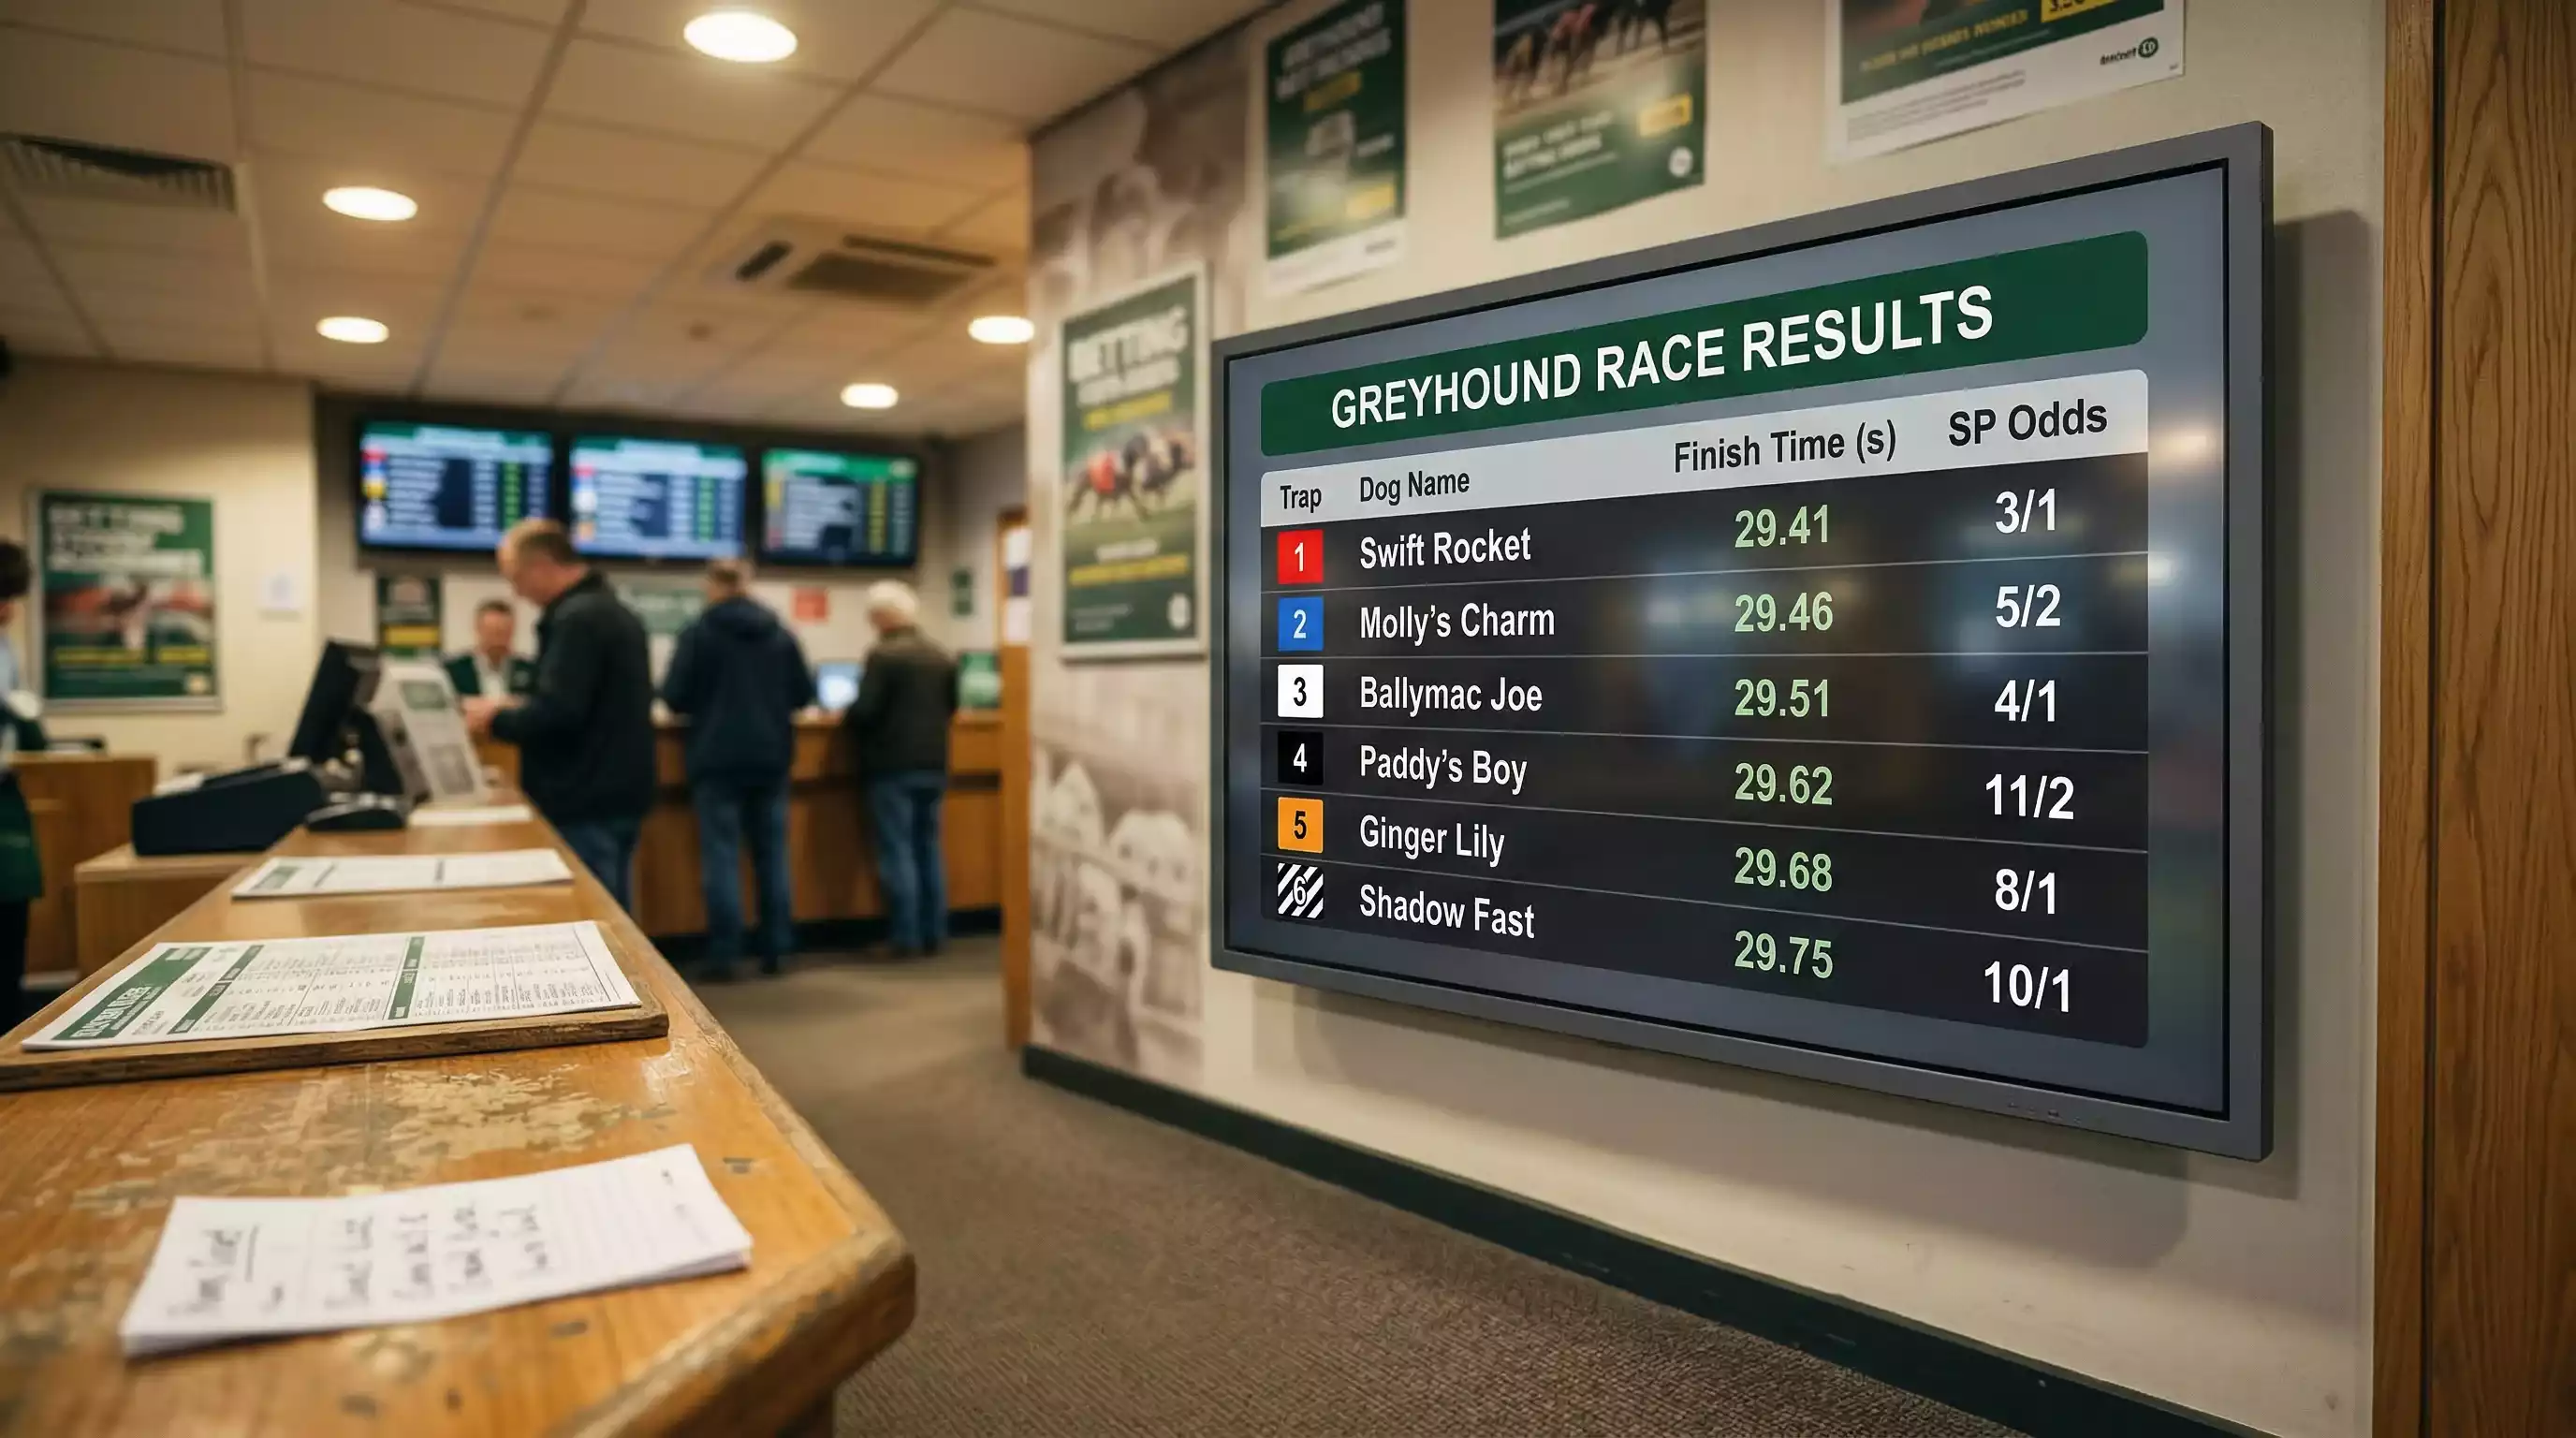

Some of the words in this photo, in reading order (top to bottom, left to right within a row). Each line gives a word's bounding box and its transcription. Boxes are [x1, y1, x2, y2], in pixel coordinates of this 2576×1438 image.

[1331, 353, 1581, 429] GREYHOUND
[1597, 328, 1725, 392] RACE
[1743, 285, 1993, 372] RESULTS
[1675, 434, 1761, 474] Finish
[1770, 430, 1845, 463] Time
[1856, 418, 1896, 464] (s)
[1948, 408, 1997, 447] SP
[2008, 398, 2108, 441] Odds
[1280, 484, 1322, 514] Trap
[1360, 476, 1401, 506] Dog
[1408, 470, 1471, 498] Name
[1294, 541, 1305, 573] 1
[1360, 533, 1426, 570] Swift
[1433, 526, 1531, 565] Rocket
[1734, 504, 1828, 549] 29.41
[1995, 488, 2056, 534] 3/1
[1293, 609, 1307, 639] 2
[1460, 602, 1555, 638] Charm
[1734, 591, 1834, 633] 29.46
[1995, 583, 2061, 628] 5/2
[1293, 676, 1308, 707] 3
[1360, 676, 1482, 718] Ballymac
[1490, 676, 1543, 712] Joe
[1734, 678, 1828, 718] 29.51
[1994, 679, 2056, 722] 4/1
[1293, 742, 1308, 772] 4
[1472, 750, 1528, 796] Boy
[1734, 762, 1833, 806] 29.62
[1985, 773, 2074, 820] 11/2
[1294, 810, 1307, 840] 5
[1360, 814, 1448, 860] Ginger
[1456, 822, 1505, 868] Lily
[1734, 846, 1833, 892] 29.68
[1995, 868, 2056, 915] 8/1
[1293, 876, 1308, 906] 6
[1359, 884, 1466, 929] Shadow
[1474, 897, 1535, 939] Fast
[1734, 930, 1834, 979] 29.75
[1984, 961, 2069, 1013] 10/1
